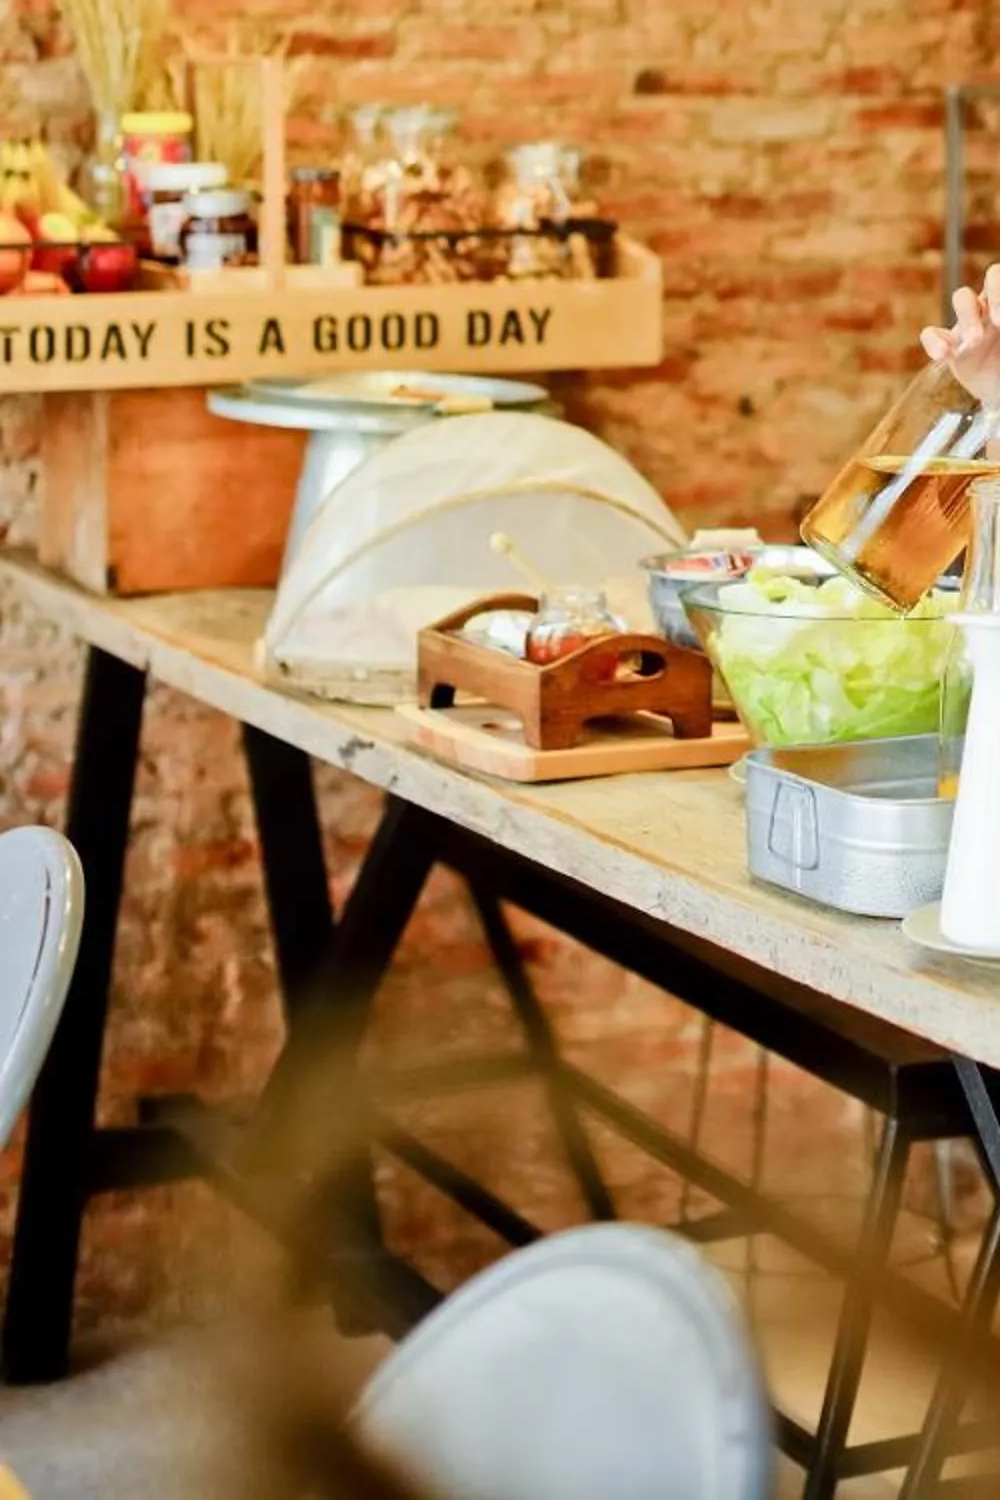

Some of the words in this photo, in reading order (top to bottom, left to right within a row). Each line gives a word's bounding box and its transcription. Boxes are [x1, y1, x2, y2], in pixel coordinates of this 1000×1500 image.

[0, 319, 156, 364] TODAY
[185, 318, 231, 358] IS
[259, 318, 286, 355] A
[312, 311, 440, 353] GOOD
[467, 307, 552, 347] DAY
